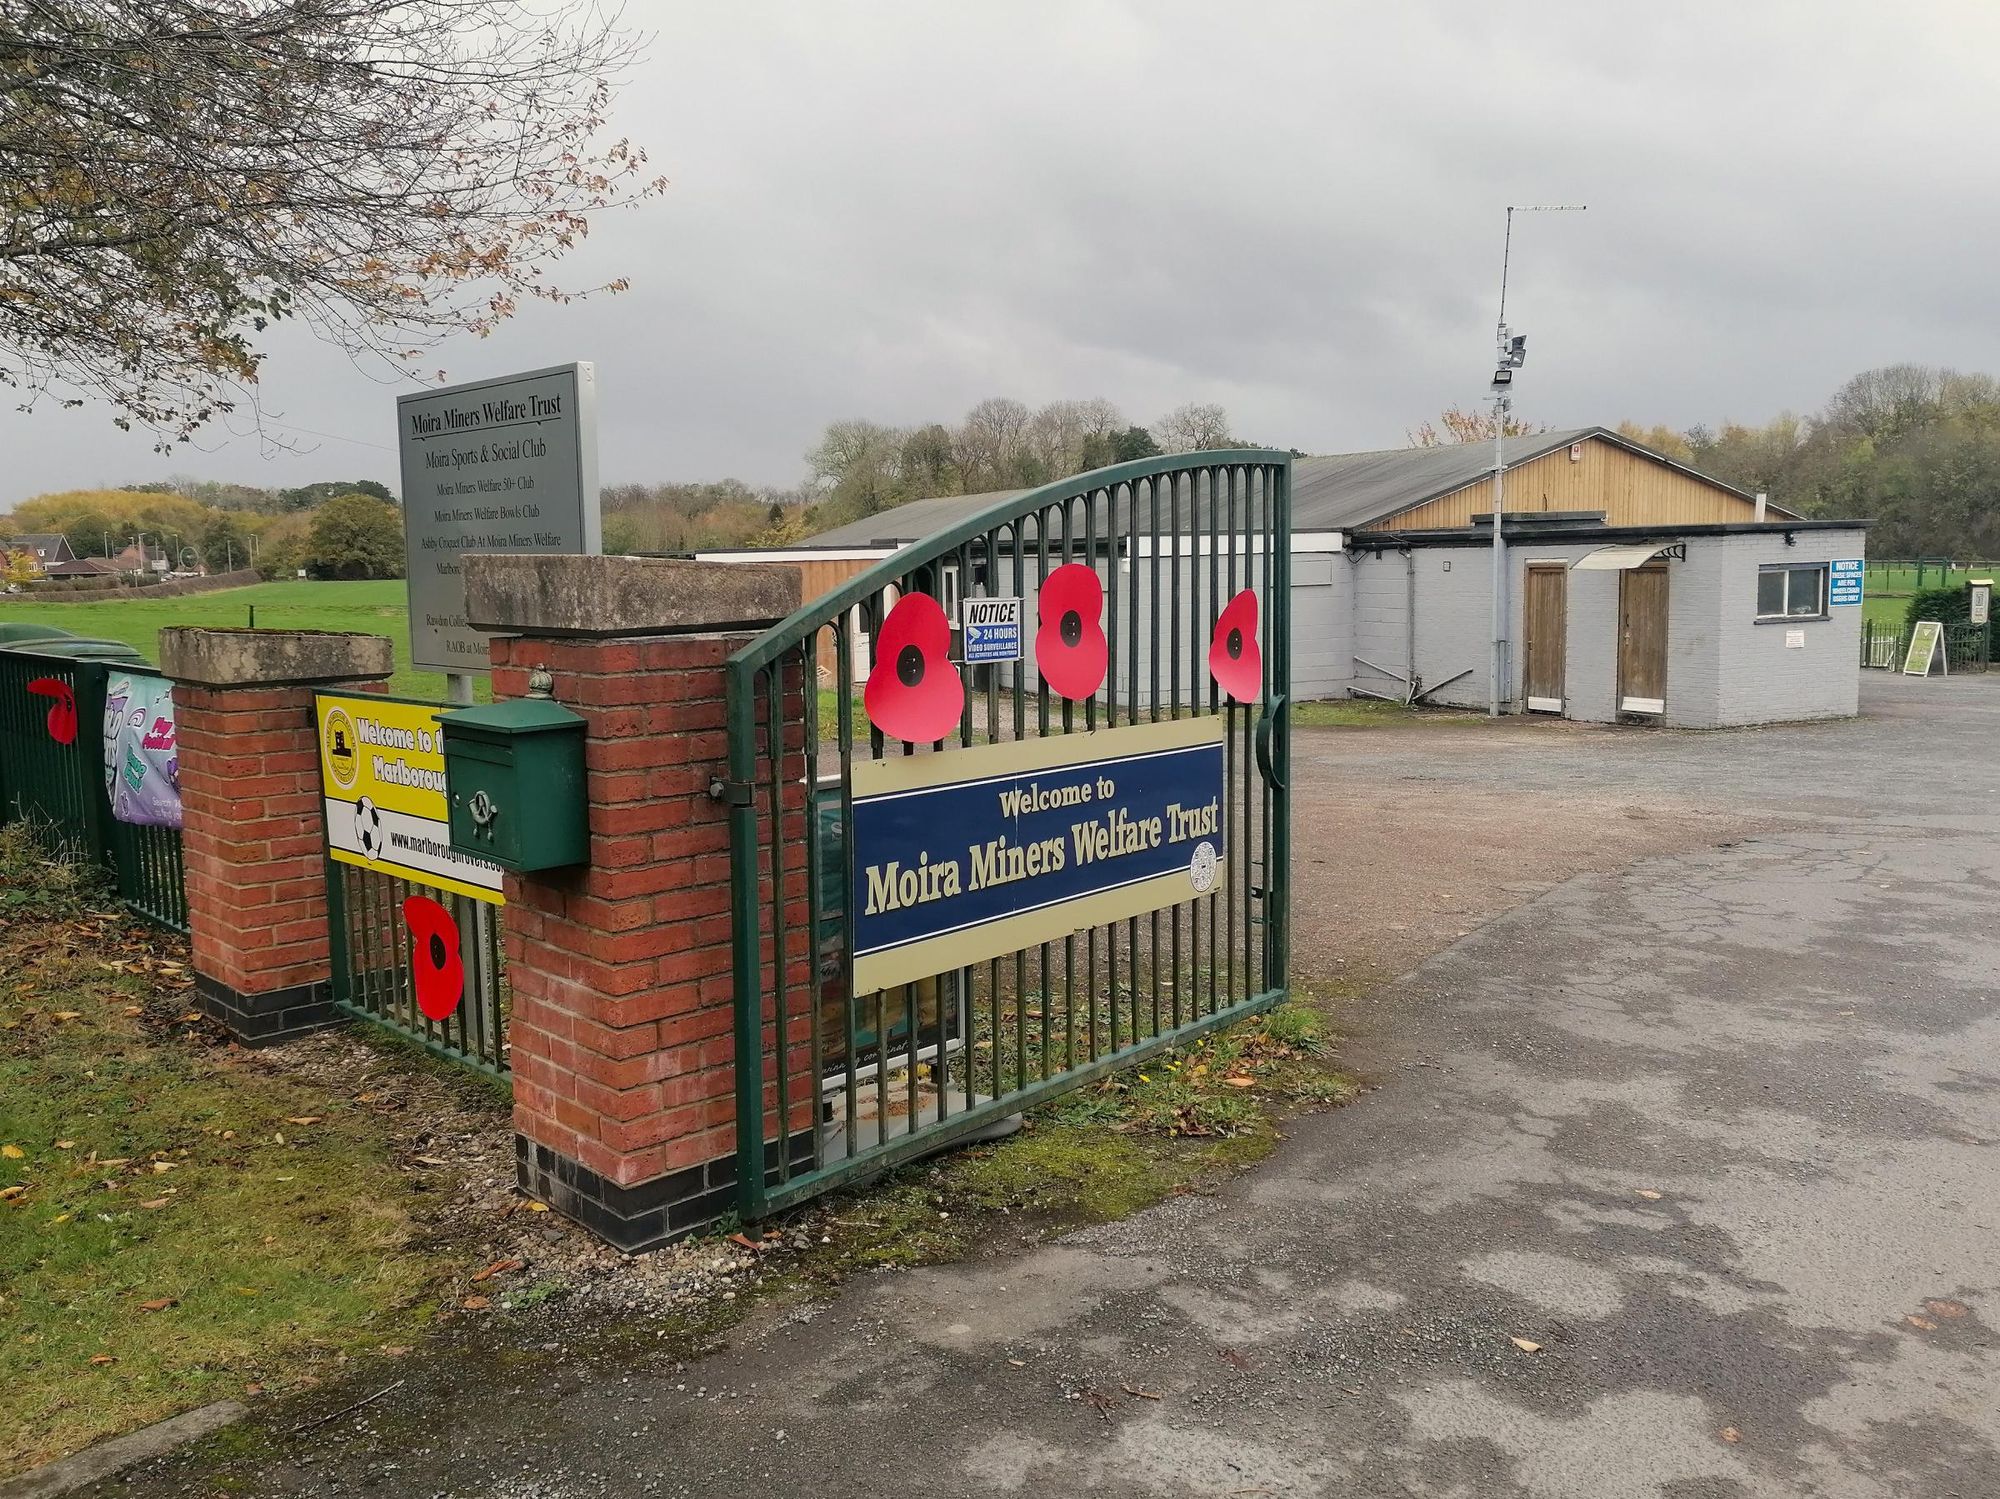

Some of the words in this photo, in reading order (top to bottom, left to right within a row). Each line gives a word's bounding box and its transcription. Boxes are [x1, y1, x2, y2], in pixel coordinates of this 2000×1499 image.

[412, 413, 441, 434] Moira
[444, 408, 480, 430] Miners
[482, 400, 526, 422] Welfare
[529, 393, 561, 417] Trust
[426, 451, 449, 469] Moira
[451, 448, 478, 471] Sports
[480, 445, 488, 463] &
[492, 441, 519, 461] Social
[522, 437, 546, 458] Club
[437, 483, 454, 496] Moira
[455, 481, 477, 495] Miners
[478, 479, 501, 493] Welfare
[517, 476, 534, 490] Club
[434, 510, 451, 522] Moira
[452, 508, 473, 521] Miners
[474, 506, 499, 520] Welfare
[500, 505, 521, 519] Bowls
[522, 504, 540, 518] Club
[461, 535, 476, 548] Club
[487, 534, 507, 548] Moira
[508, 532, 533, 547] Miners
[534, 531, 561, 547] Welfare
[1836, 561, 1859, 570] NOTICE
[969, 603, 1016, 624] NOTICE
[984, 630, 993, 640] 24
[994, 628, 1017, 639] HOURS
[968, 644, 982, 652] VIDEO
[984, 642, 1017, 651] SURVEILLANCE
[356, 717, 414, 750] Welcome
[417, 727, 432, 753] to
[999, 783, 1092, 819] Welcome
[1097, 776, 1115, 802] to
[864, 851, 962, 917] Moira
[968, 834, 1065, 892] Miners
[1071, 807, 1162, 867] Welfare
[1166, 796, 1219, 842] Trust
